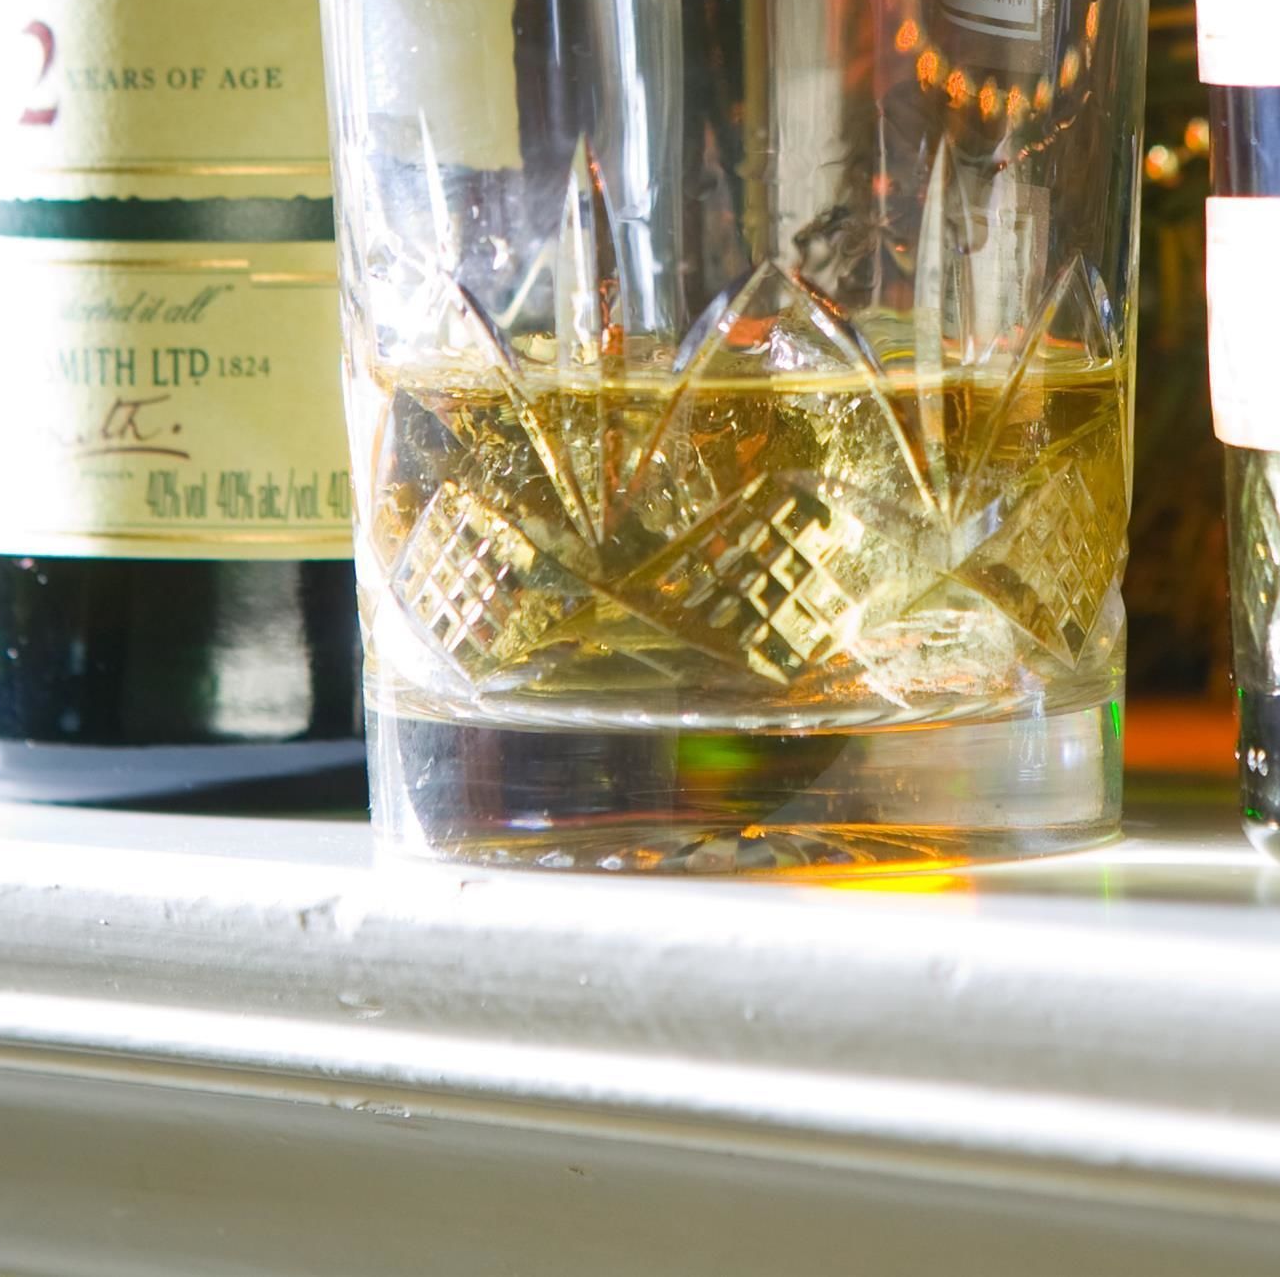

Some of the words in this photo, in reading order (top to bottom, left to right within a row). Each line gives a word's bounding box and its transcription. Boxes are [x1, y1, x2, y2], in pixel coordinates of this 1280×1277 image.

[65, 66, 157, 91] YEARS
[166, 66, 208, 91] OF
[219, 65, 284, 91] AGE
[219, 355, 272, 379] 1824
